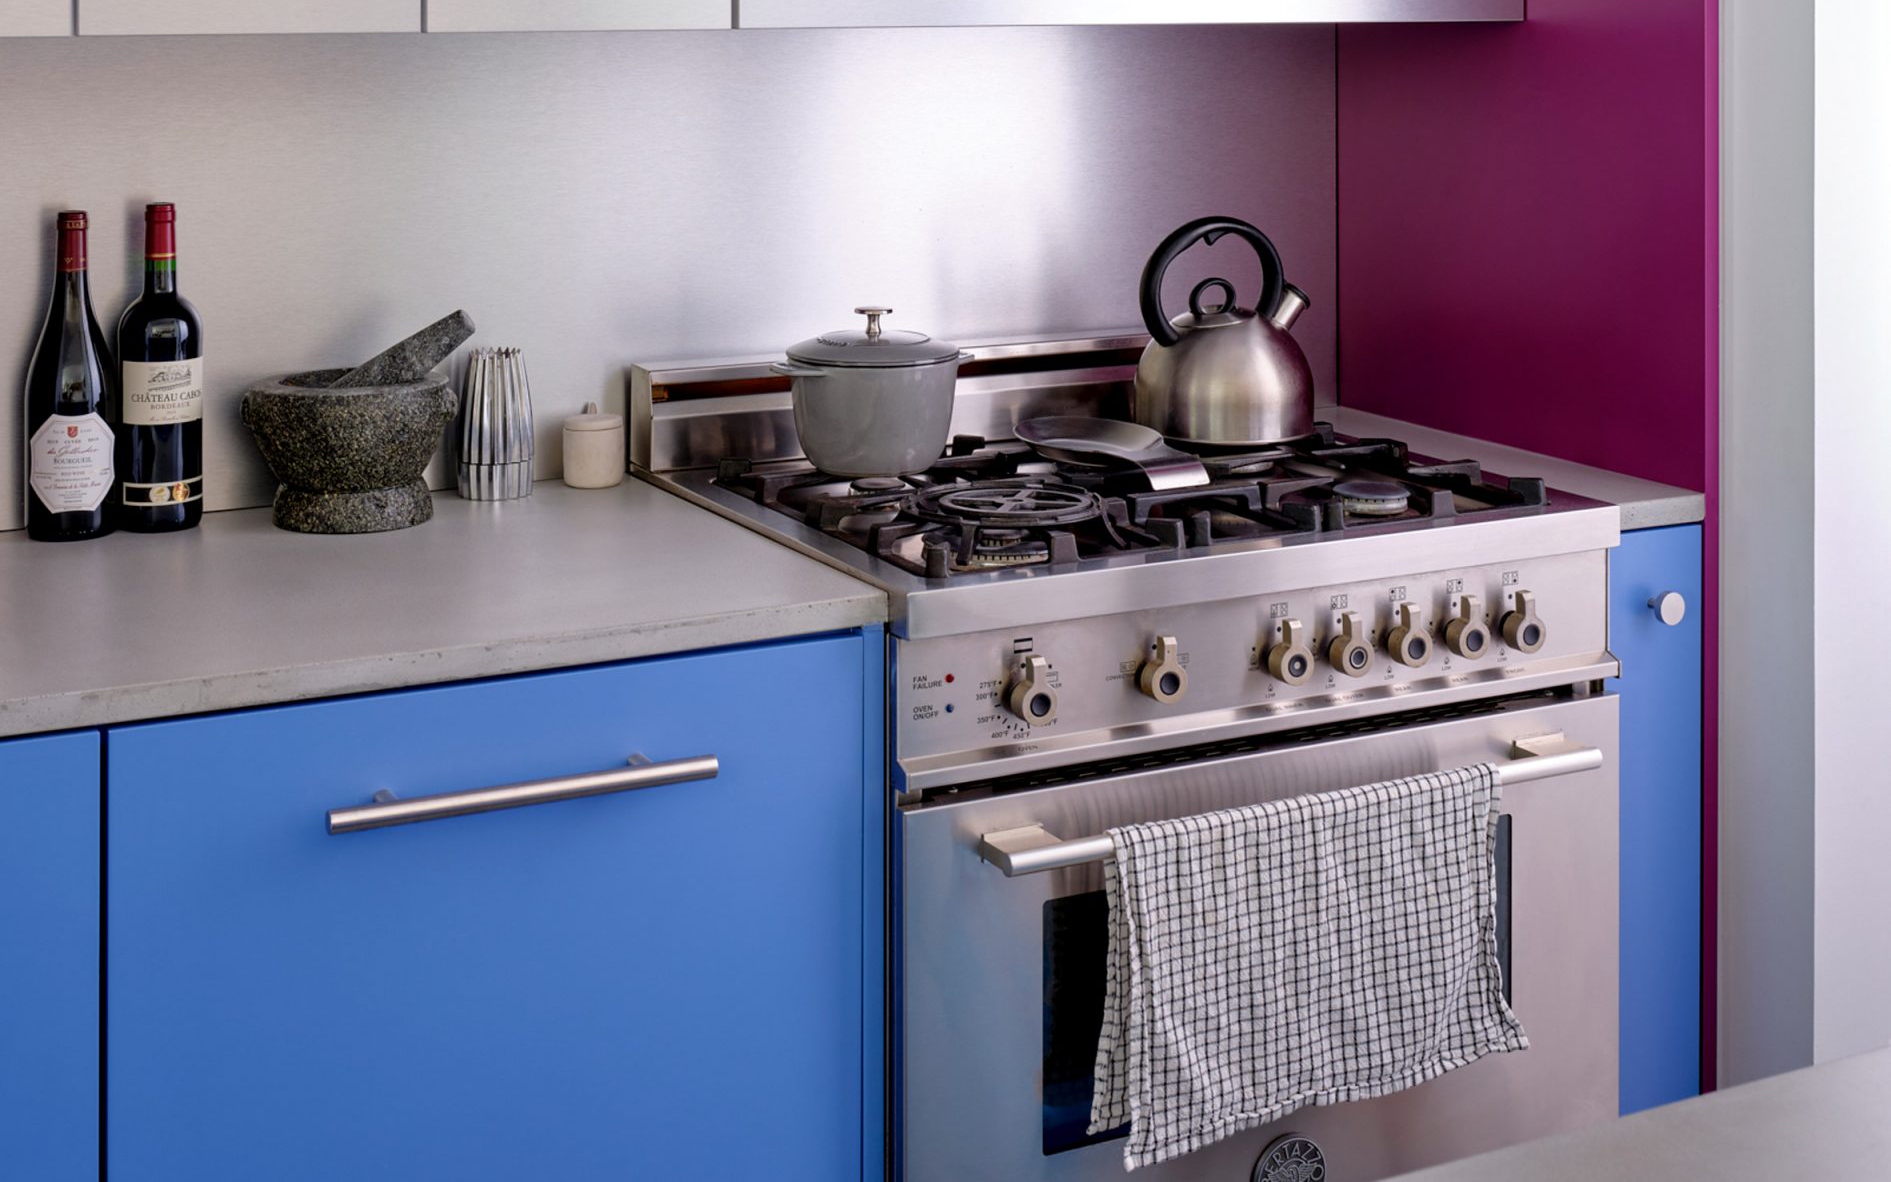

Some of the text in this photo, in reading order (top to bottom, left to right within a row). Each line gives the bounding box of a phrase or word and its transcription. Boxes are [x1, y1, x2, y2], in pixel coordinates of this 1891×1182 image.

[131, 392, 178, 403] CHÂTEAU
[913, 675, 928, 683] FAN
[913, 681, 943, 690] FAILURE
[913, 705, 933, 714] OVEN
[913, 711, 939, 721] ON/OFF
